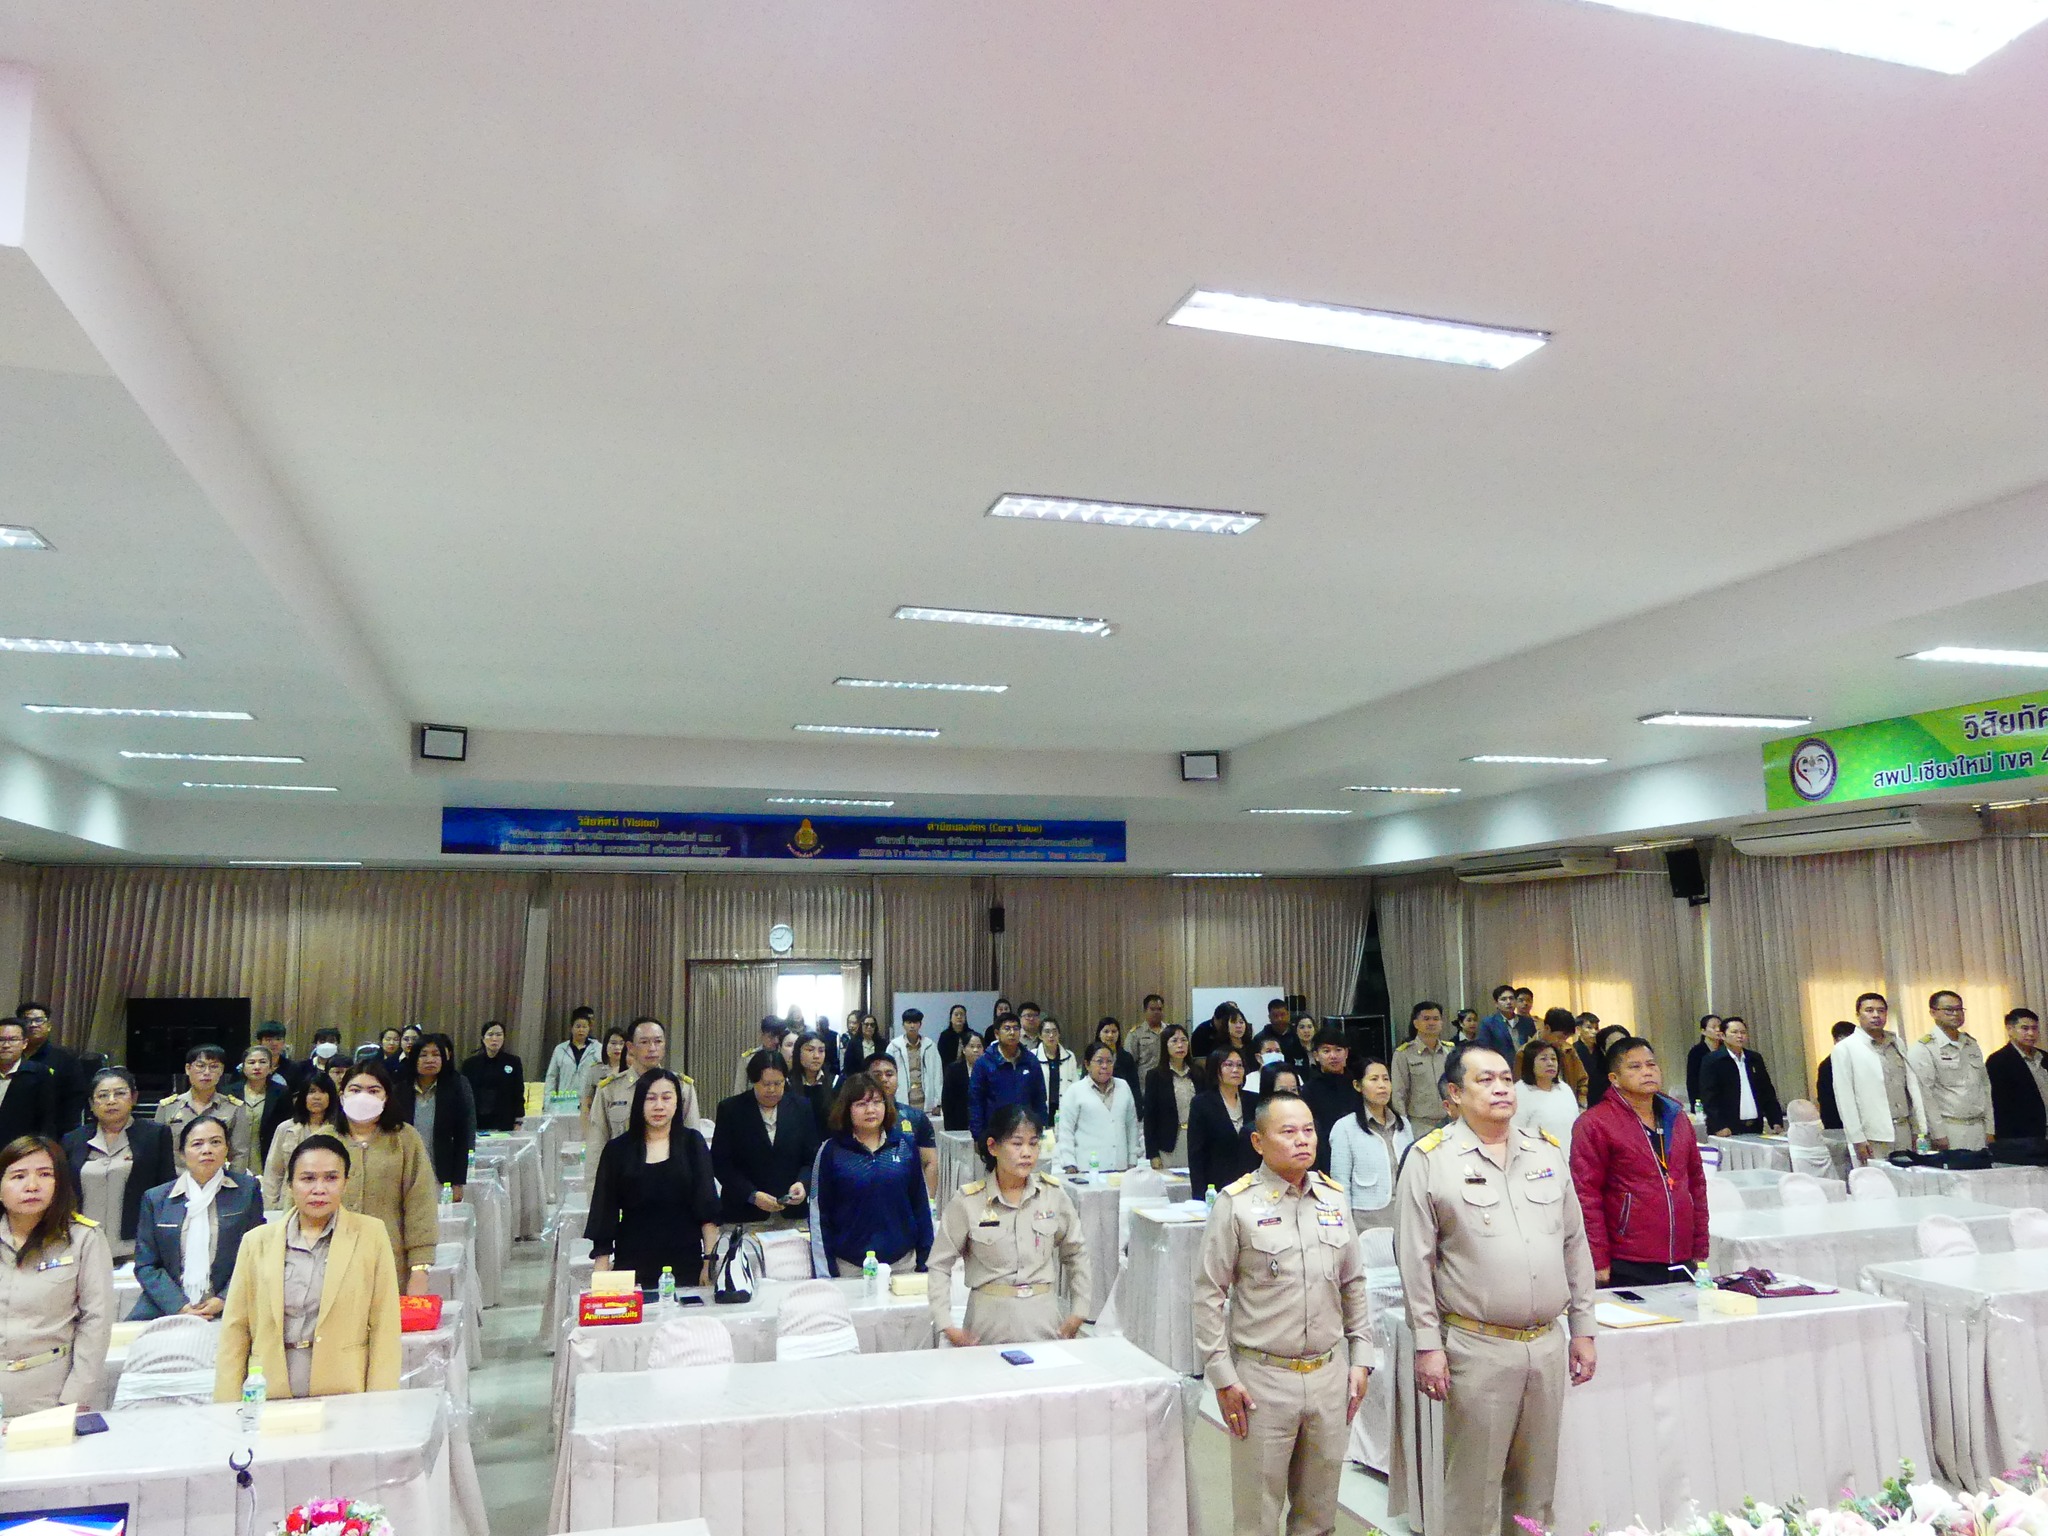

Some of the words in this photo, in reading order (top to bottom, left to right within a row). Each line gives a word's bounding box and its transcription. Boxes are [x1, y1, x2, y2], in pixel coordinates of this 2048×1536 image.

[1873, 751, 1993, 788] สพป.เชียงใหม่
[2000, 751, 2034, 771] เขต
[622, 817, 660, 828] (Vision)
